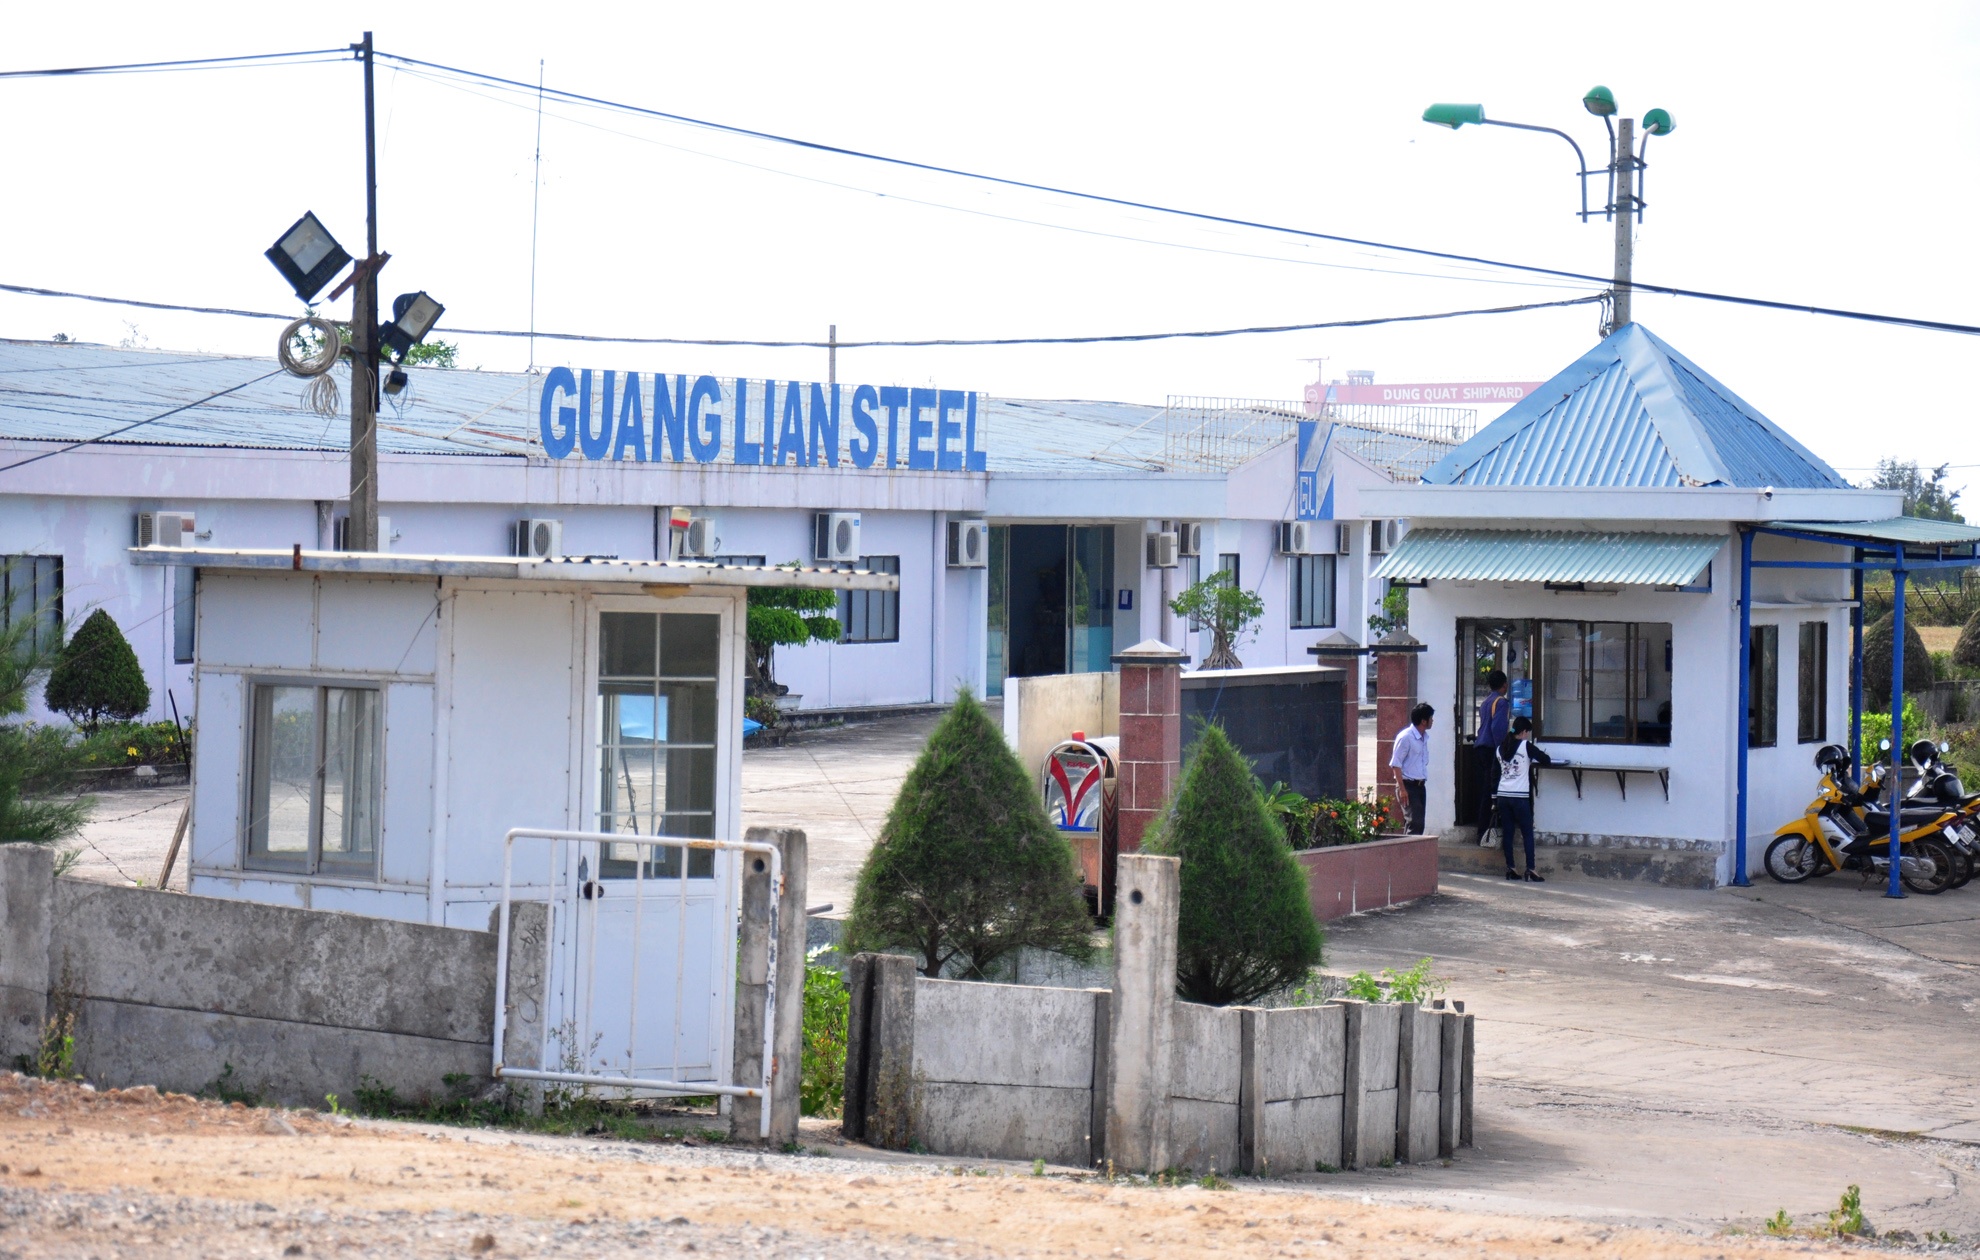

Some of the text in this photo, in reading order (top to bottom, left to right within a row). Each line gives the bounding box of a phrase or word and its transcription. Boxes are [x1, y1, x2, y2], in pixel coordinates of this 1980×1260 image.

[540, 366, 987, 473] GUANG LIAN STEEL
[1383, 386, 1524, 402] DUNG QUAT SHIPYARD
